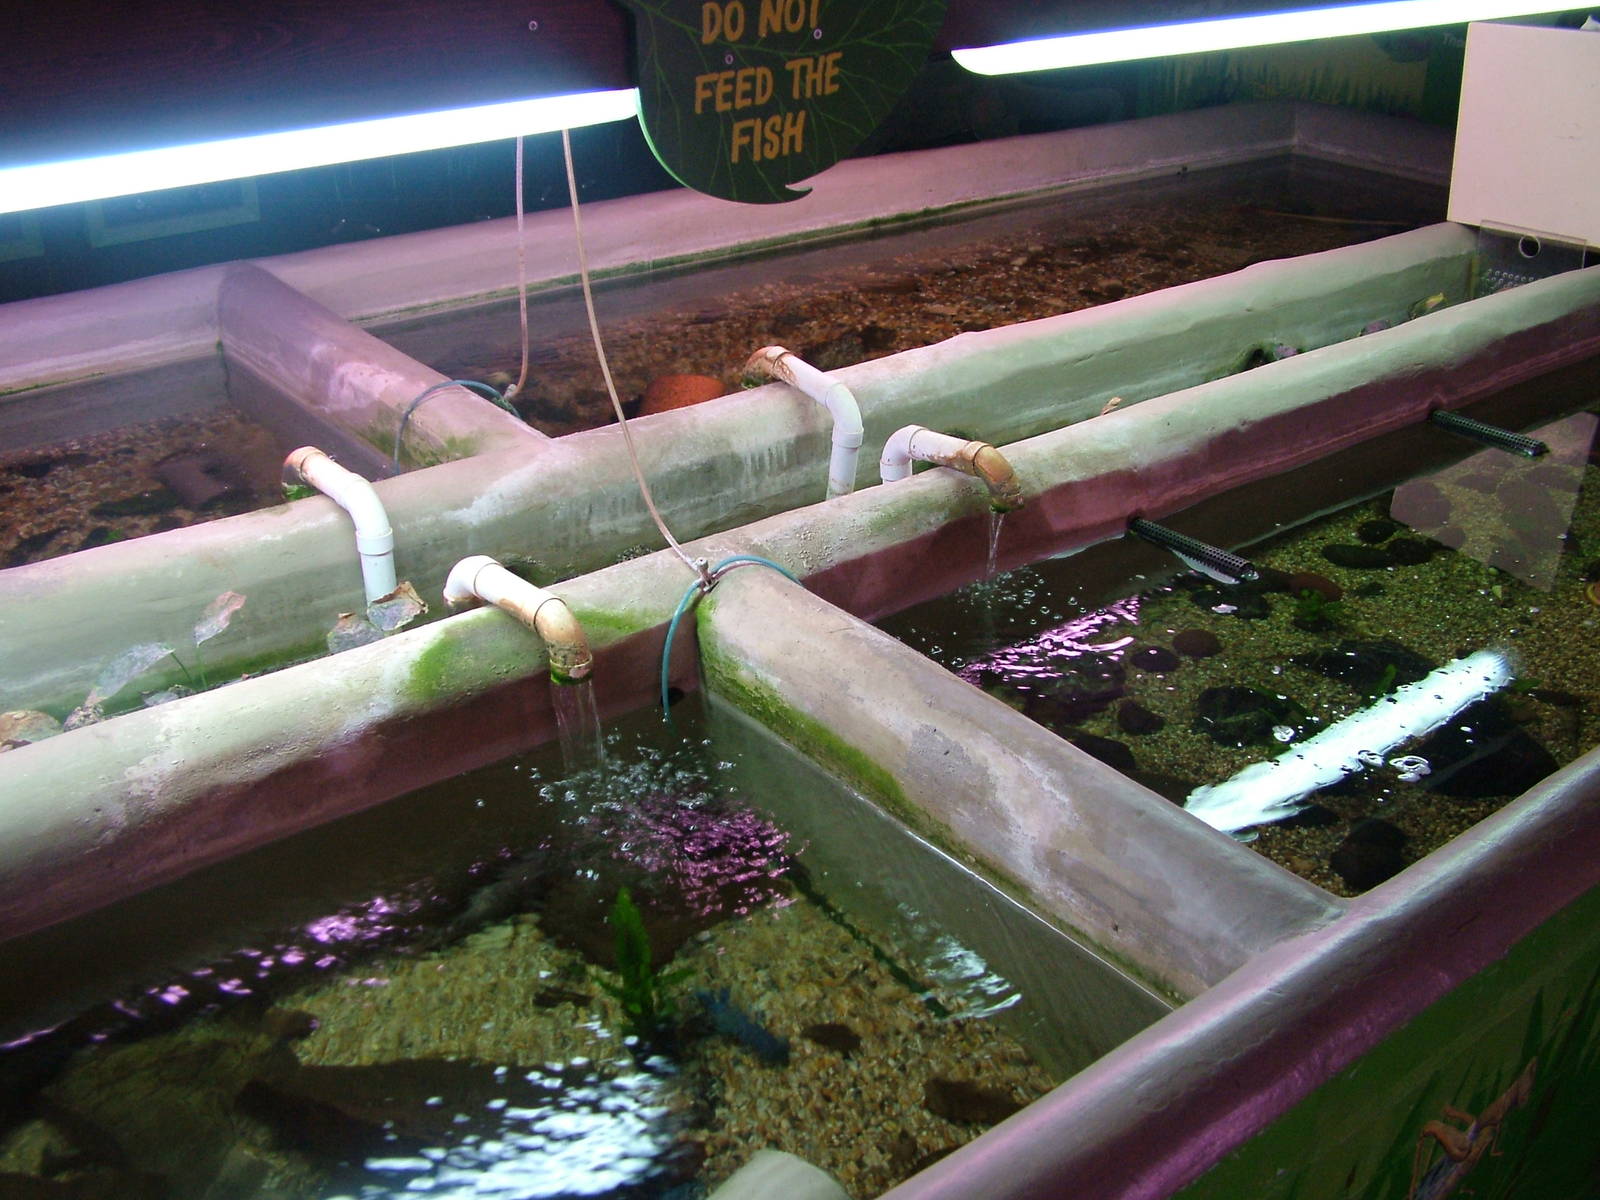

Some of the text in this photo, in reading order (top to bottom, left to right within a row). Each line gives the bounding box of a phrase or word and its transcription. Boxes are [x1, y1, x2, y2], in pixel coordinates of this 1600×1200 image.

[701, 1, 746, 44] DO
[694, 52, 843, 114] FEED THE
[731, 110, 806, 163] FISH
